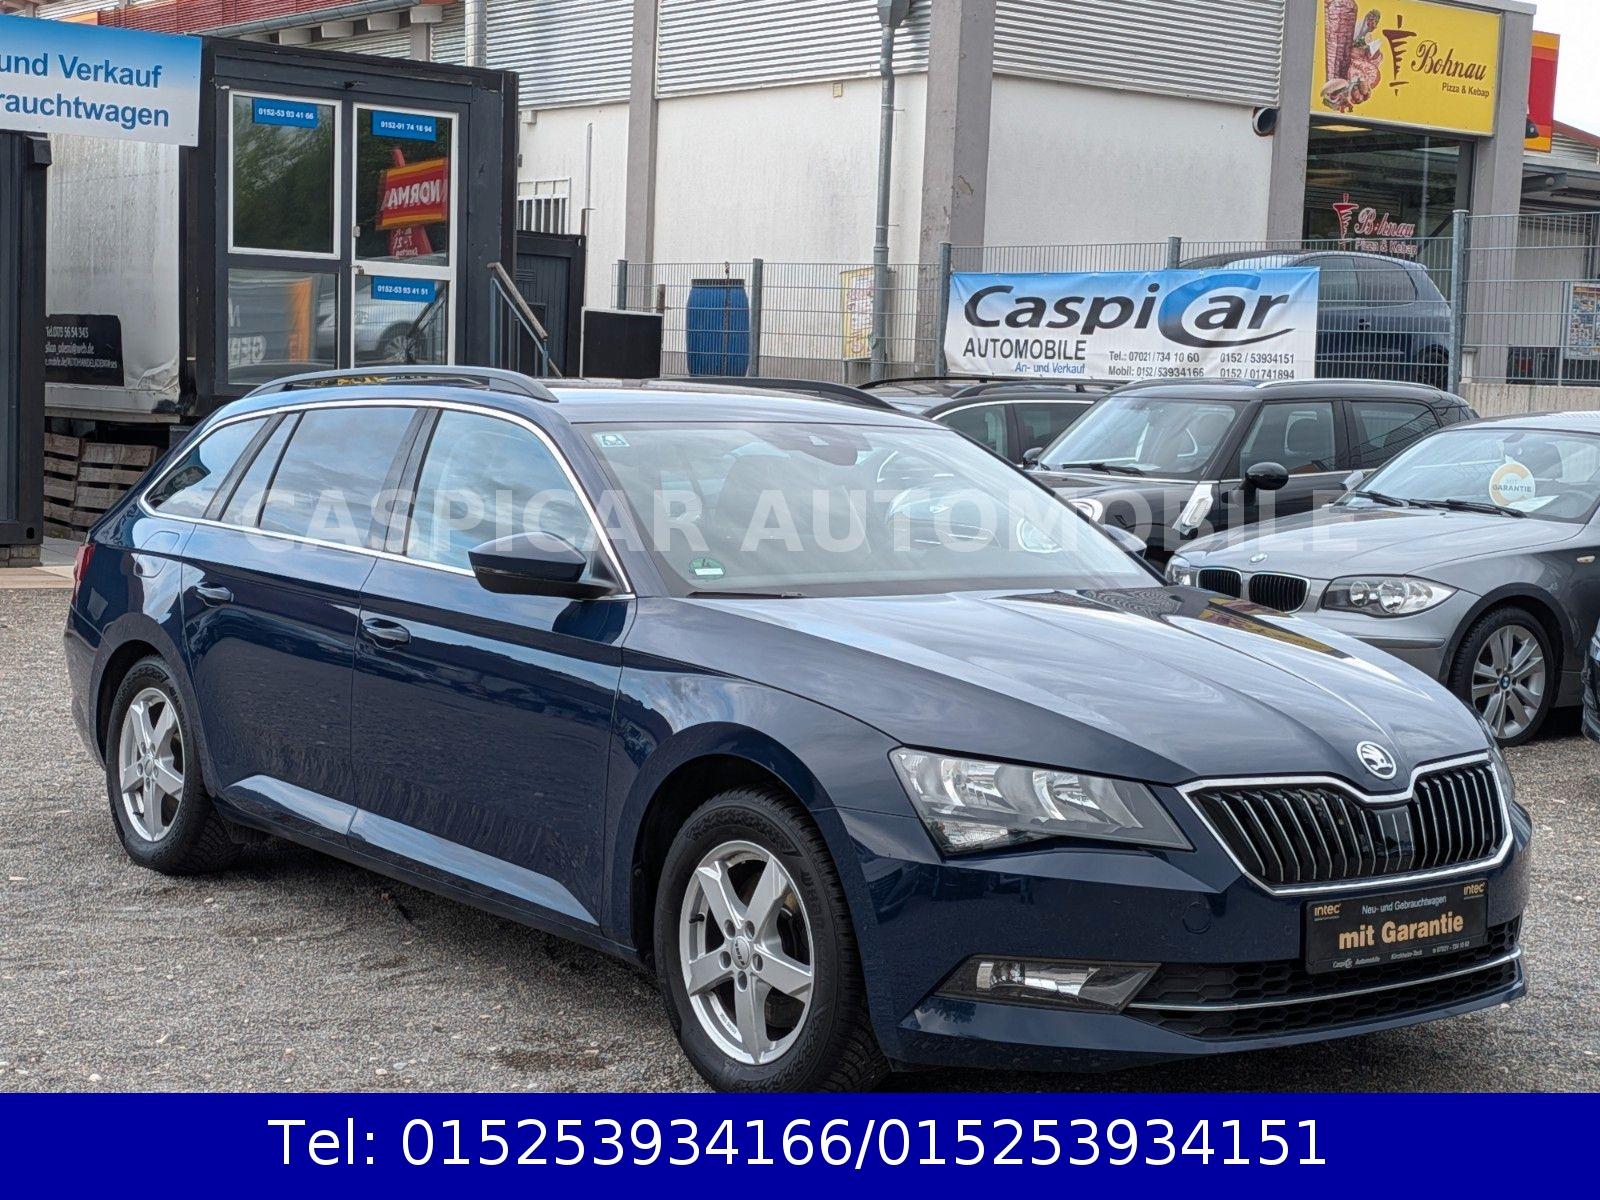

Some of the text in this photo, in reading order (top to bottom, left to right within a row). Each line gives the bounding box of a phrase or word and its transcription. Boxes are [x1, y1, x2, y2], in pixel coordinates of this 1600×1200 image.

[1411, 40, 1487, 80] Bohnau
[0, 53, 162, 88] und Verkauf
[1442, 82, 1490, 99] Pizza & Kebap
[964, 273, 1296, 349] CaspiCar
[963, 338, 1087, 360] AUTOMOBILE
[1109, 350, 1127, 361] Tel.:
[1174, 352, 1184, 363] 10
[1187, 353, 1200, 363] 60
[1220, 353, 1242, 363] 0152
[1250, 353, 1294, 364] 53934151
[1015, 362, 1085, 374] An- und Verkauf
[1108, 366, 1135, 376] Mobil:
[1220, 368, 1242, 378] 0152
[1250, 369, 1295, 379] 01741894
[1492, 484, 1532, 493] GARANTIE
[1463, 882, 1486, 896] intec
[1314, 903, 1342, 917] intec
[1362, 895, 1447, 915] Neu- und Gebrauchtwagen
[1338, 911, 1464, 950] mit Garantie
